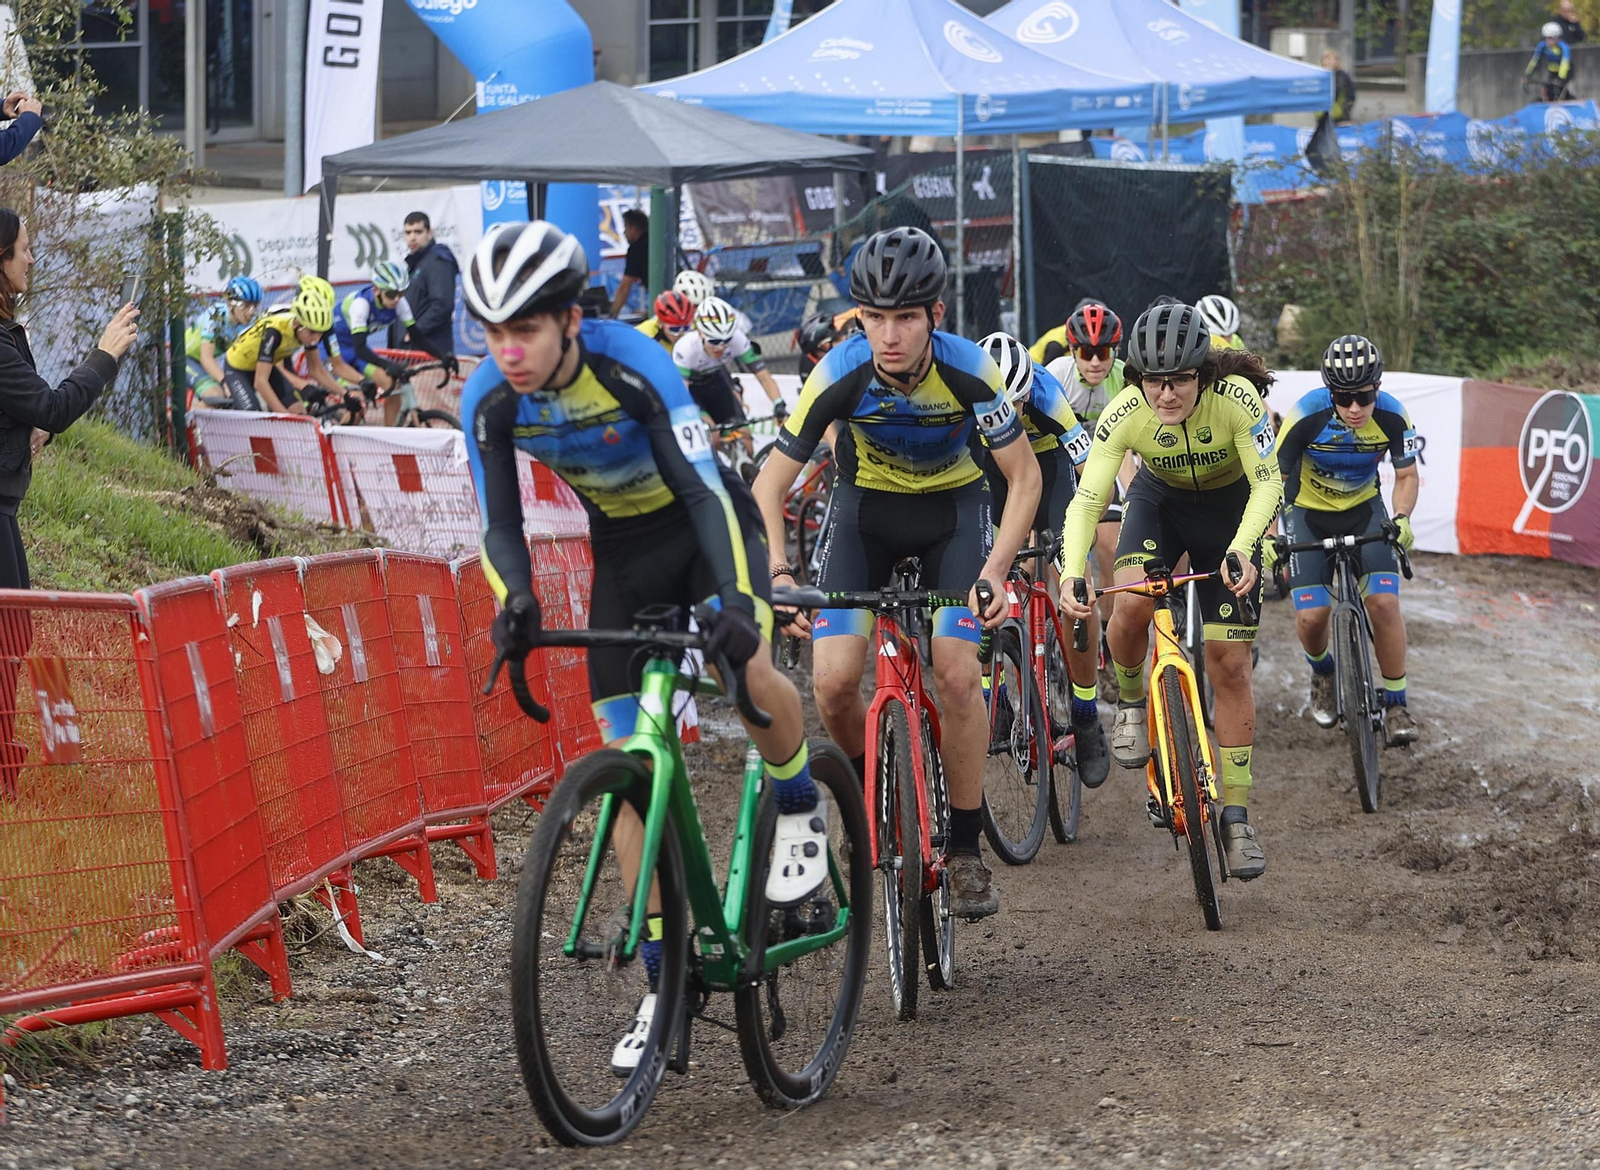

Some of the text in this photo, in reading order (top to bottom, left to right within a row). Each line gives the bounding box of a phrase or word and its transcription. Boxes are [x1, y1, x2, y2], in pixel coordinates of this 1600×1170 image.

[982, 401, 1011, 428] 910
[1103, 397, 1139, 428] TOCHO
[1228, 382, 1260, 418] TOCHO
[1067, 433, 1091, 456] 913
[1151, 448, 1228, 470] CAIMANES
[1527, 428, 1588, 473] PFO
